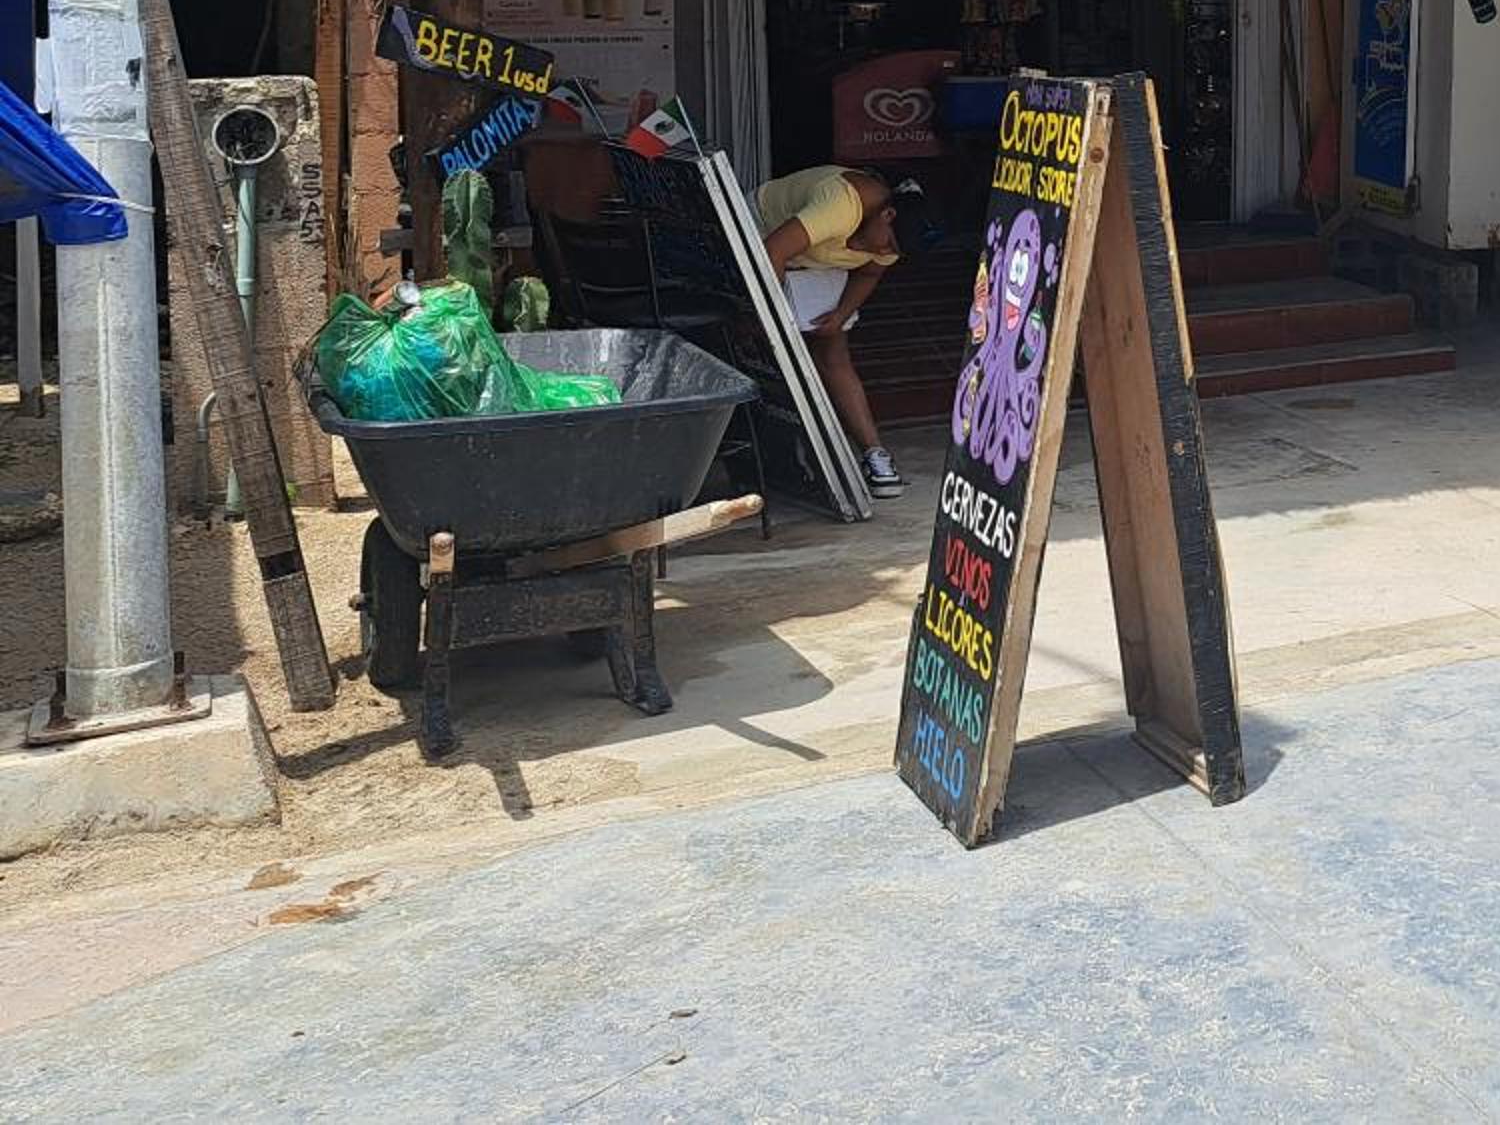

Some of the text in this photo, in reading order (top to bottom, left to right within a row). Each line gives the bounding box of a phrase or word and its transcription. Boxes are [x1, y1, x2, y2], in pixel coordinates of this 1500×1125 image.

[416, 21, 493, 79] BEER
[439, 95, 540, 175] PALOMITAS
[1001, 90, 1082, 165] OCTOPUS
[941, 471, 1016, 559] CERVEZAS
[944, 532, 993, 611] VINOS
[925, 584, 993, 681] LICORES
[913, 637, 983, 744] BOTANAS
[914, 707, 965, 799] HIELO
